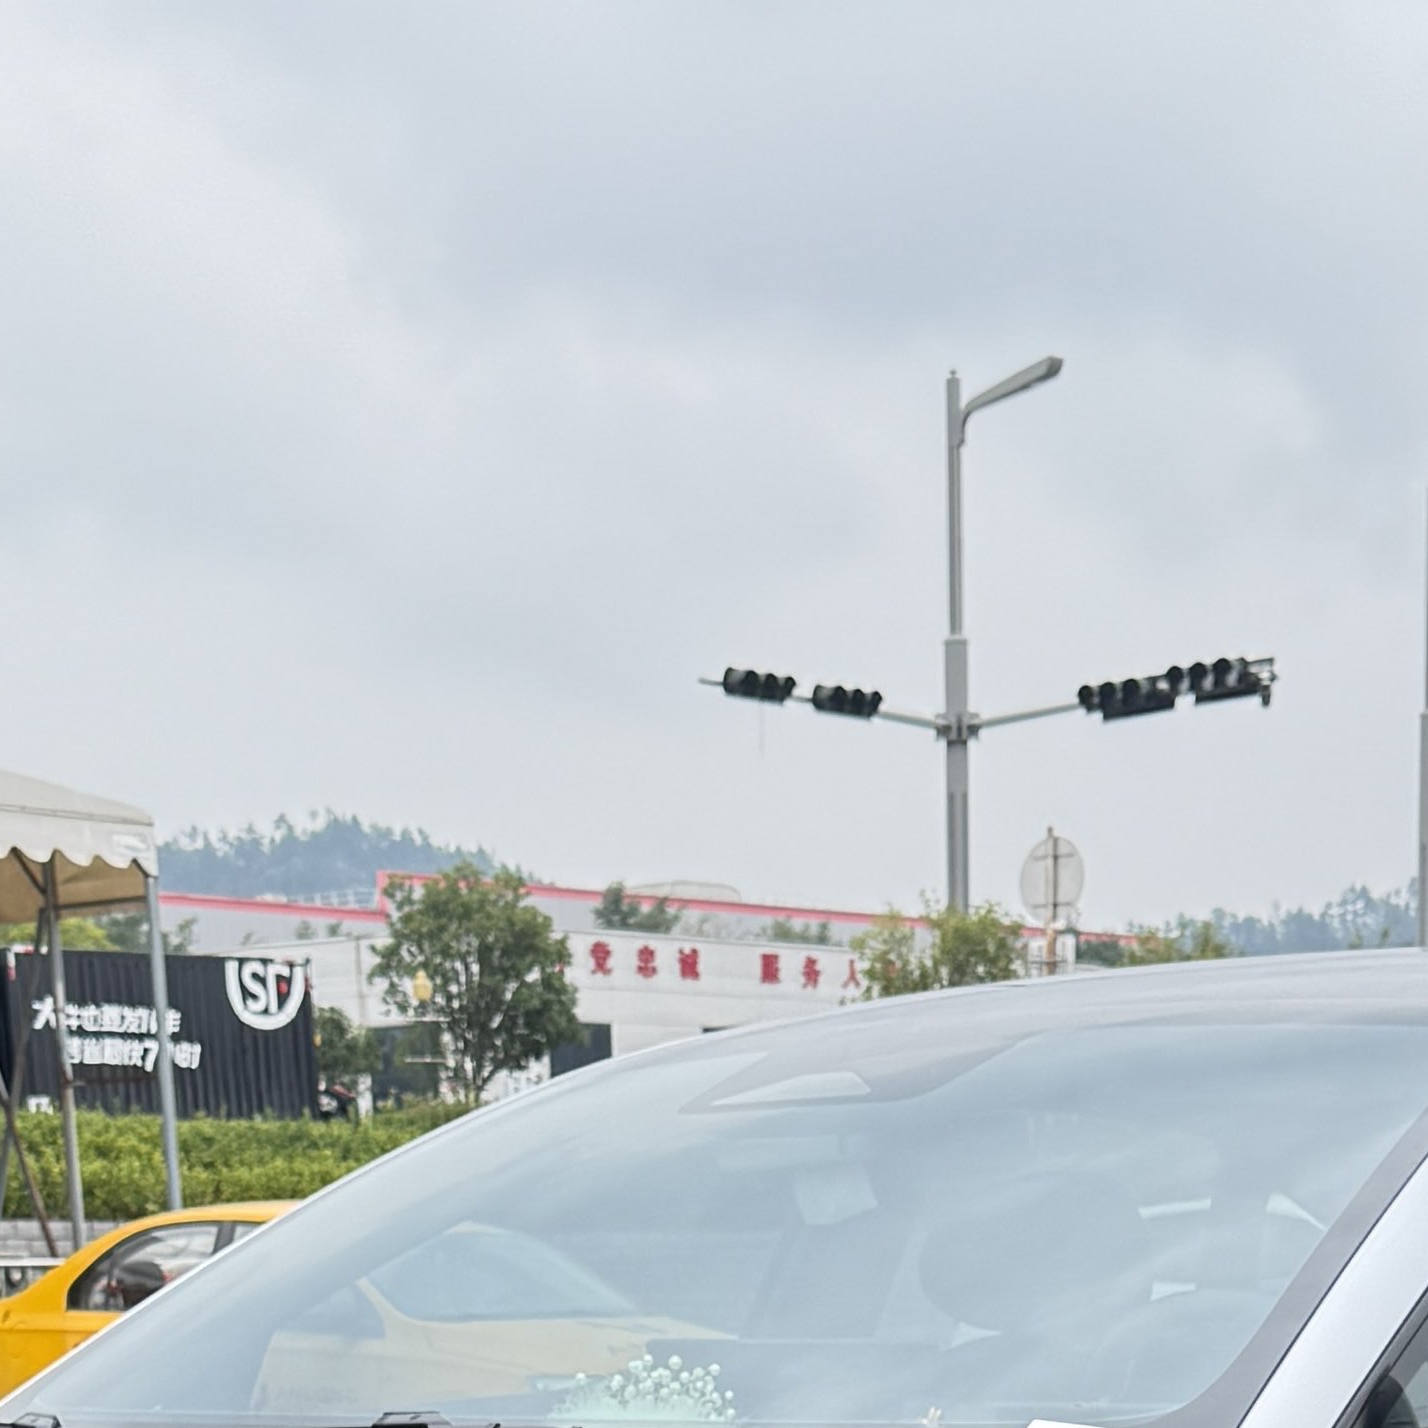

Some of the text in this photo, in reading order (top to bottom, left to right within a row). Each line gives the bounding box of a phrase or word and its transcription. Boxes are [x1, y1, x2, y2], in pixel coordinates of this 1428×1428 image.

[556, 940, 899, 990] 党忠诚 服务人
